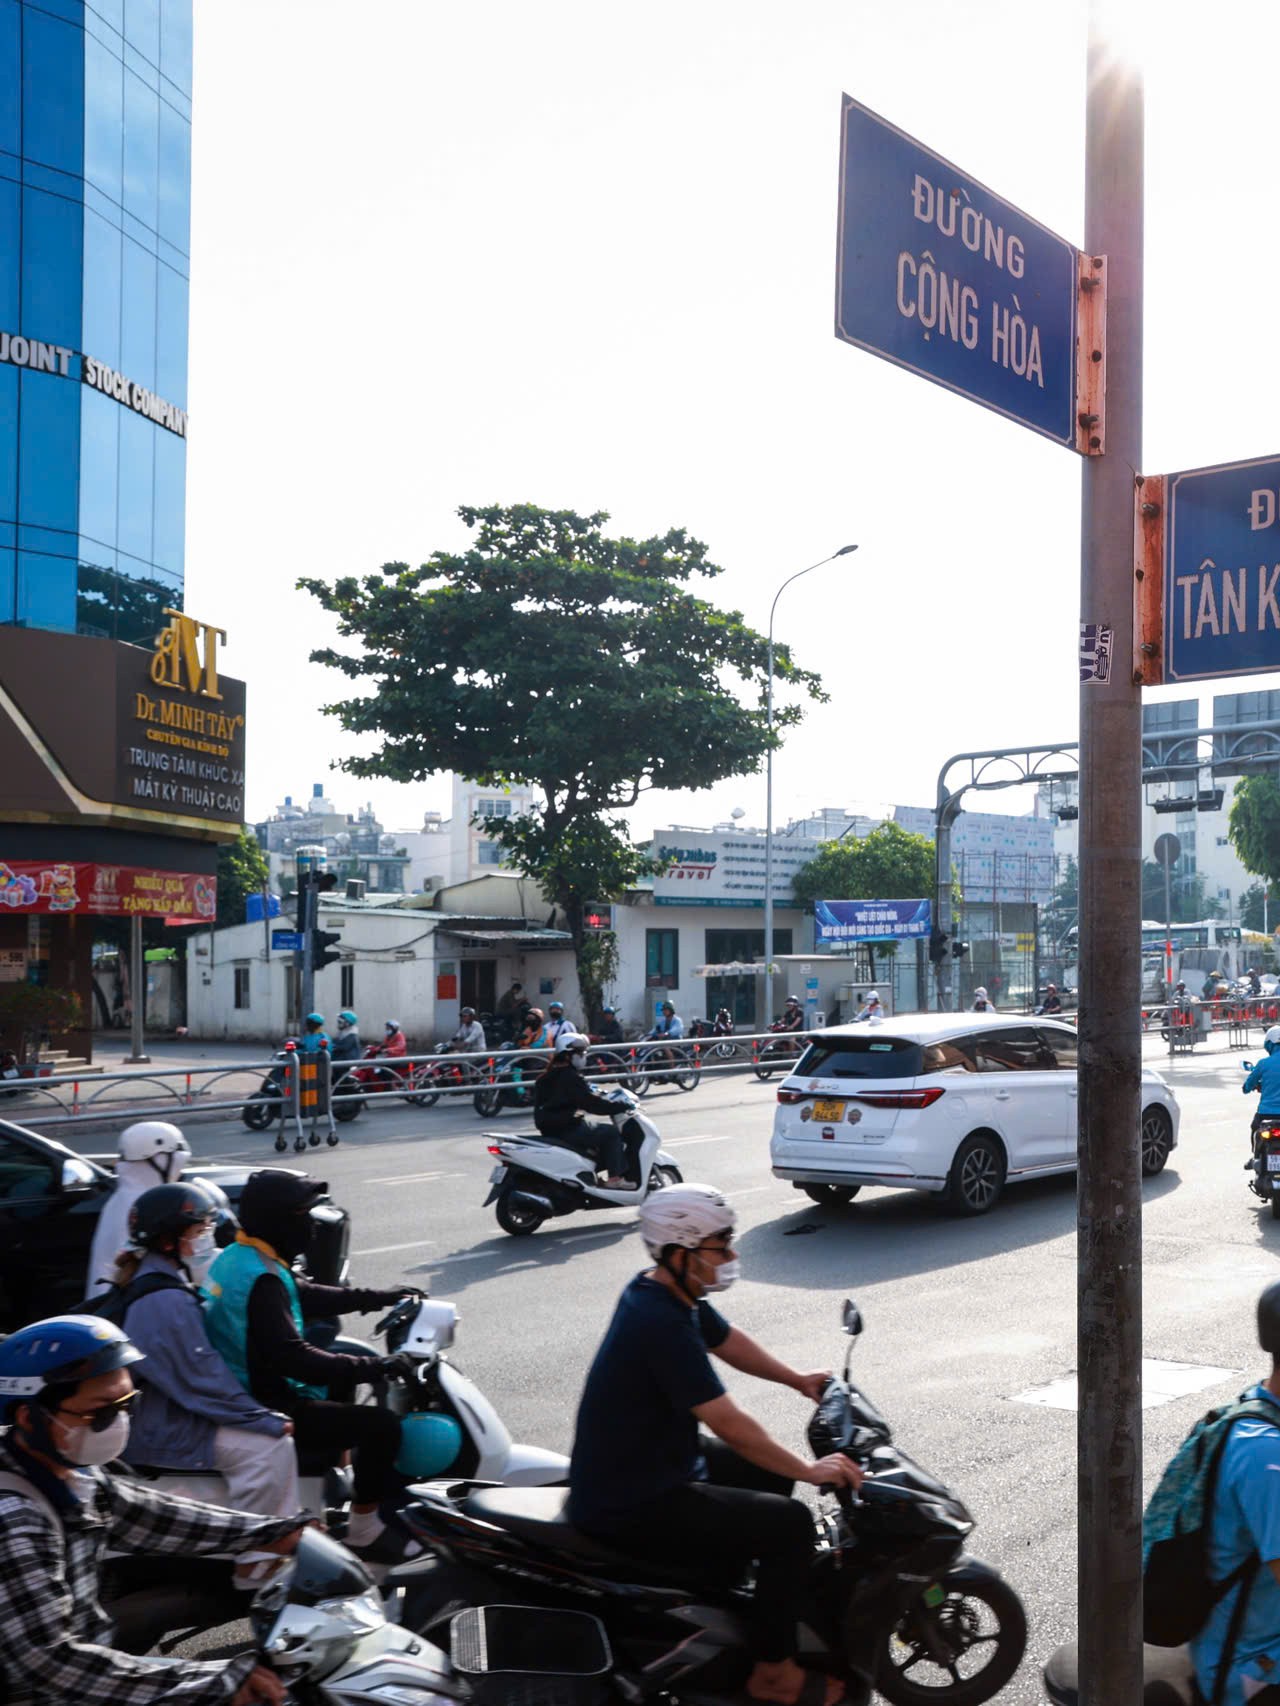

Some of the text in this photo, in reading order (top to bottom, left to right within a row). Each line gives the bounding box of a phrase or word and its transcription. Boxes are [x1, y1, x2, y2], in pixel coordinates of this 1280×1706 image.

[911, 174, 1025, 279] ĐƯỜNG
[897, 250, 1044, 389] CỘNG HÒA
[0, 332, 73, 376] JOINT
[86, 355, 189, 437] STOCK COMPANY
[1176, 558, 1247, 640] TÂN
[160, 700, 206, 734] MINH
[130, 747, 169, 771] TRUNG
[172, 753, 196, 776] TÂM
[217, 794, 241, 812] CAO
